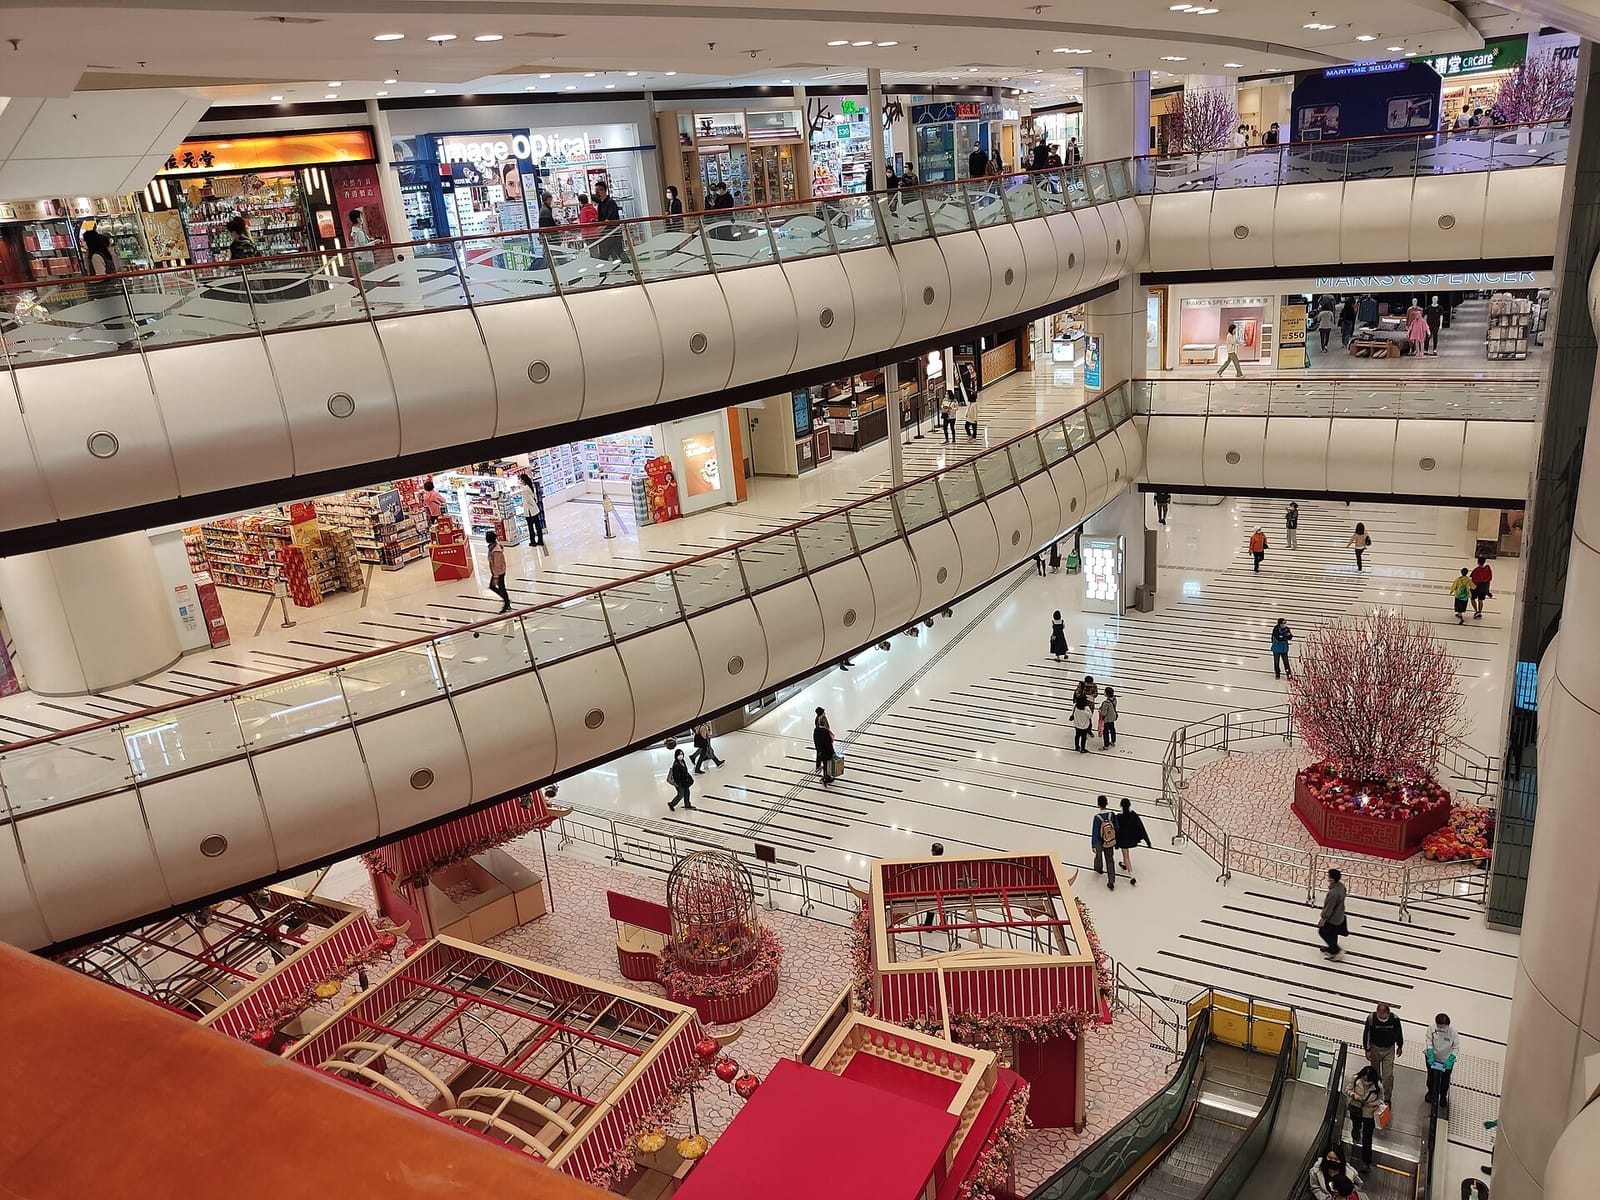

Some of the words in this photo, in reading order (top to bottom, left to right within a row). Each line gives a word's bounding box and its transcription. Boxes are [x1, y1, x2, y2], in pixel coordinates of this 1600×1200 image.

[1326, 66, 1367, 77] MARITIME
[1368, 62, 1406, 73] SQUARE
[434, 138, 508, 168] image
[511, 131, 590, 167] Optical
